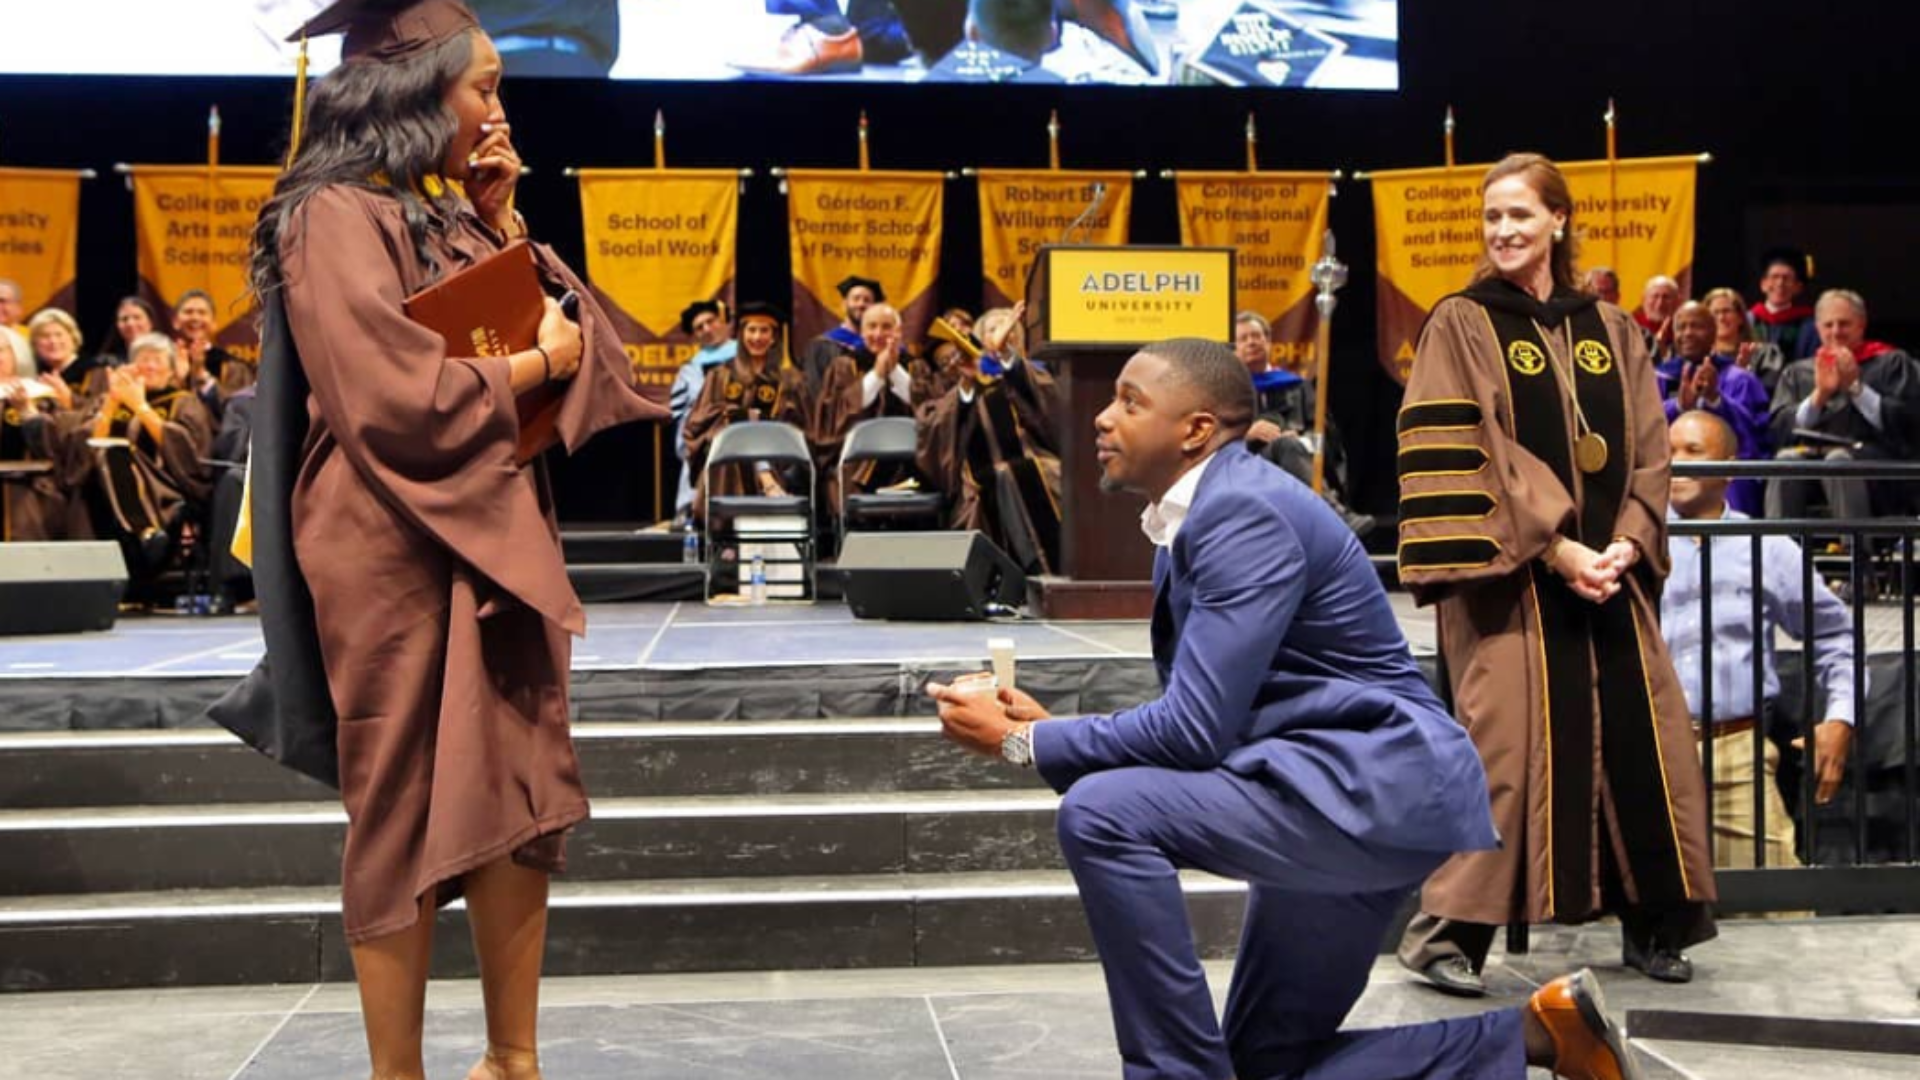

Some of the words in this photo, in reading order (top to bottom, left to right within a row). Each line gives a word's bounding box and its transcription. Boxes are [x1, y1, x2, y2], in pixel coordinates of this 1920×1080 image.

[1005, 185, 1075, 202] Robert
[1202, 180, 1276, 202] College
[1279, 181, 1298, 198] of
[1404, 185, 1473, 202] College
[157, 193, 240, 215] College
[817, 193, 890, 212] Gordon
[1574, 192, 1671, 215] niversity
[608, 213, 682, 231] School
[686, 213, 708, 231] of
[1191, 204, 1311, 223] Professional
[1406, 205, 1482, 224] Educatio
[167, 220, 210, 239] Arts
[796, 217, 860, 234] Derner
[866, 218, 931, 236] School
[1235, 228, 1270, 244] and
[1403, 230, 1435, 246] and
[598, 239, 663, 258] Social
[668, 239, 720, 258] Work
[821, 242, 931, 262] Psychology
[1082, 273, 1200, 292] ADELPHI
[1238, 273, 1290, 291] udies
[1085, 301, 1193, 312] UNIVERSITY
[623, 343, 701, 368] DELP
